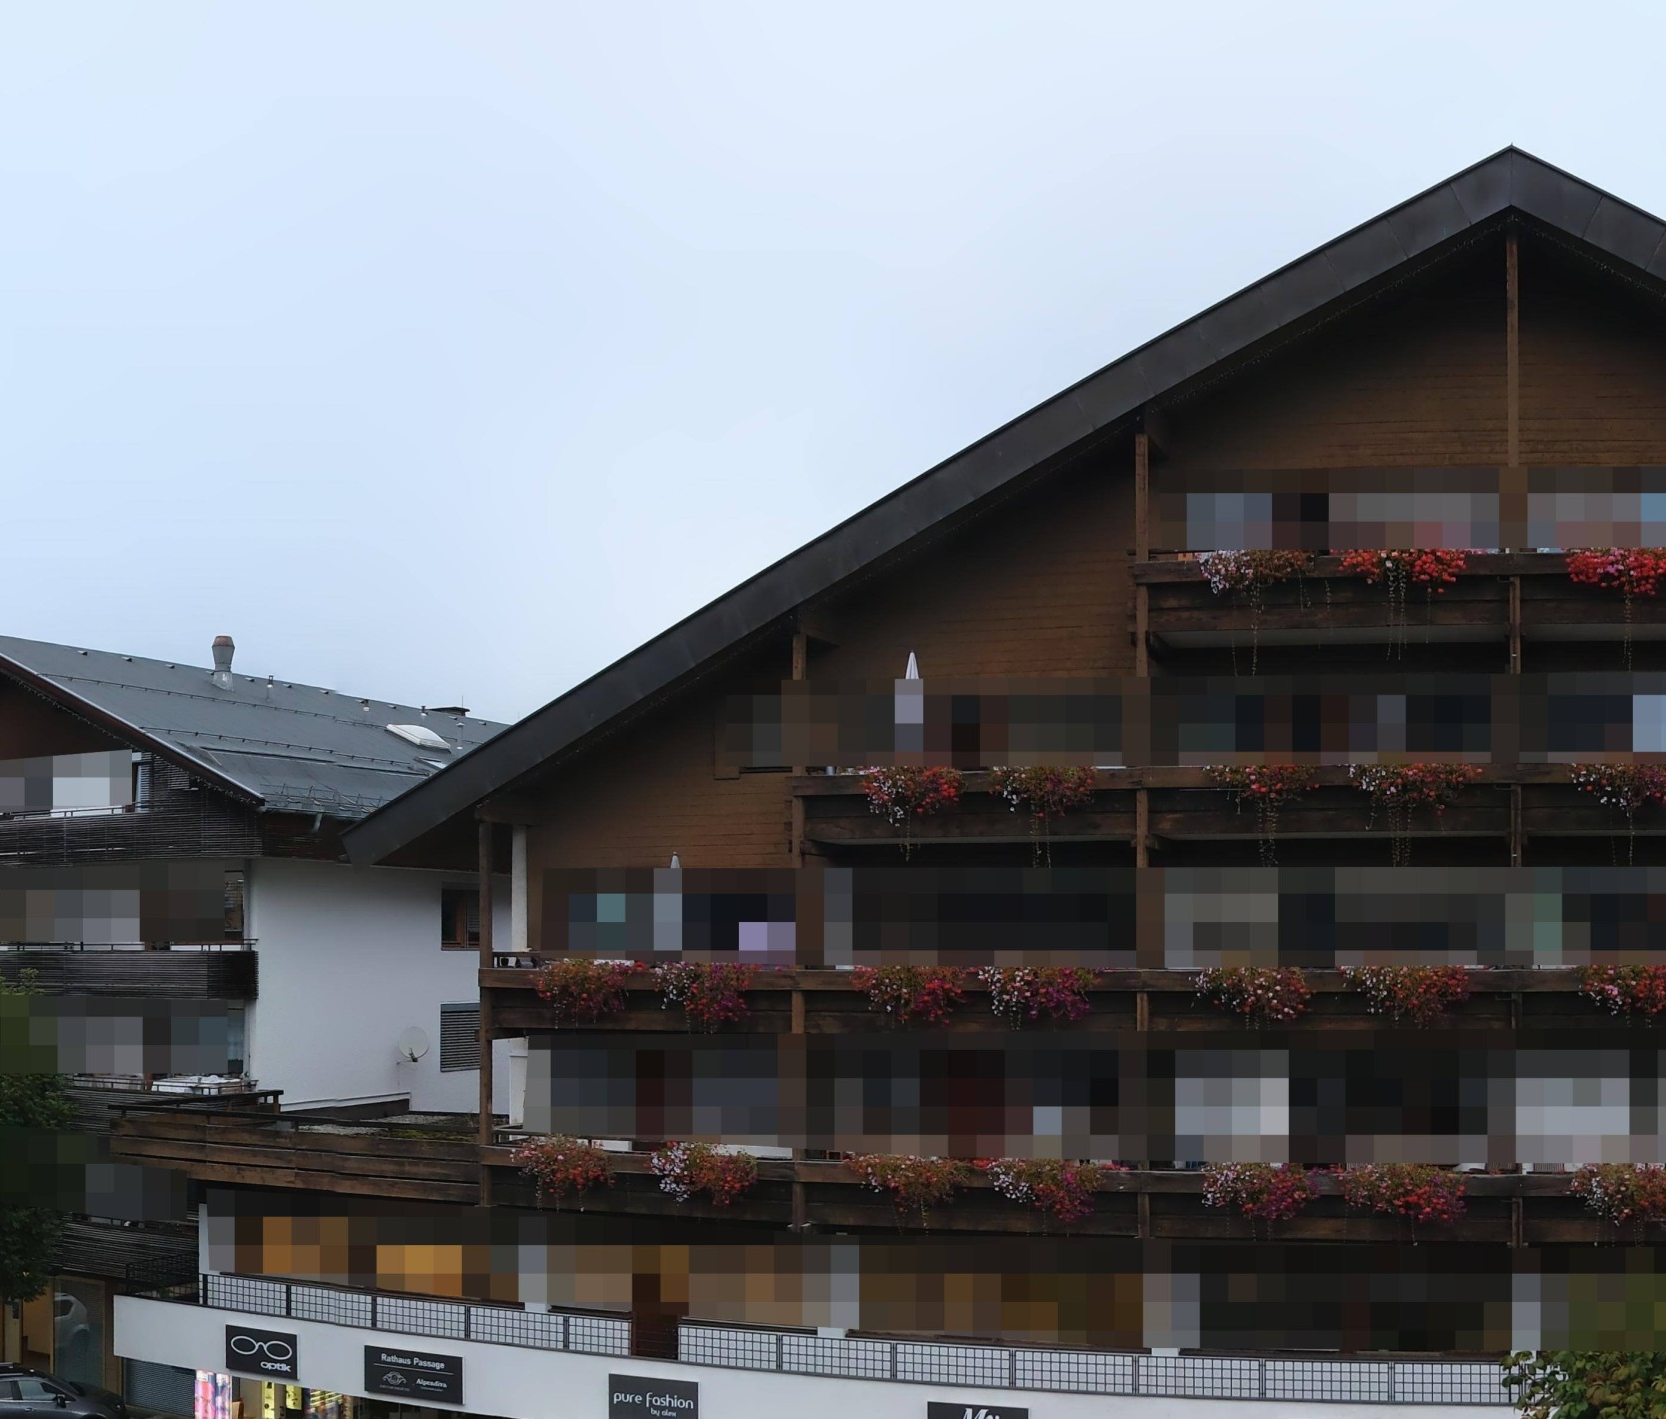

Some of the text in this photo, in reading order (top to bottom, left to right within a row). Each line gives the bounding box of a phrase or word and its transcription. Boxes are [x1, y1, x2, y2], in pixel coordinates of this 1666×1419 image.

[260, 1360, 292, 1373] optik
[381, 1353, 445, 1370] Rathaus Passage
[613, 1392, 694, 1409] pure fashion
[650, 1407, 677, 1418] by alex
